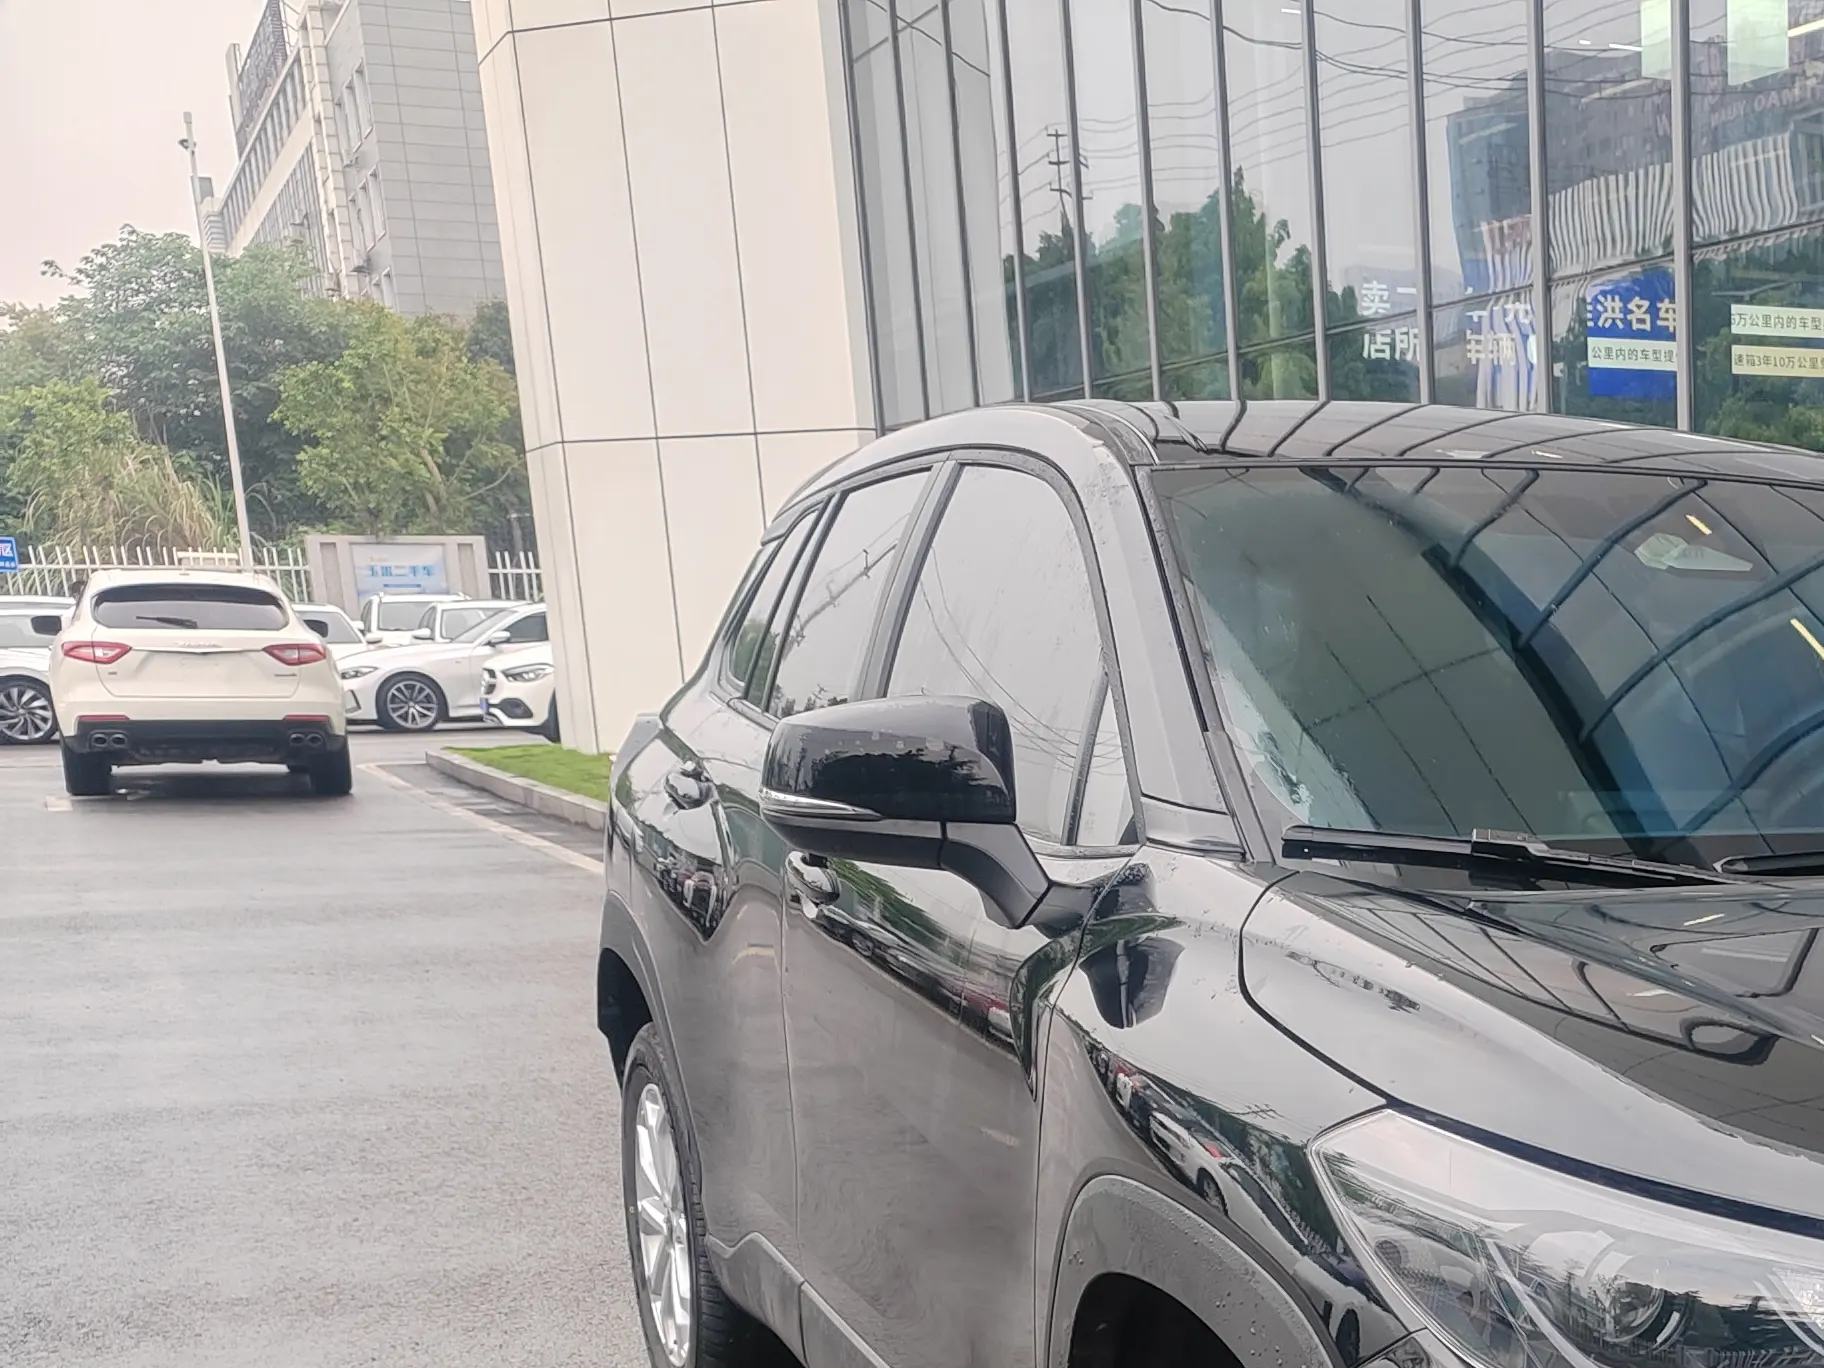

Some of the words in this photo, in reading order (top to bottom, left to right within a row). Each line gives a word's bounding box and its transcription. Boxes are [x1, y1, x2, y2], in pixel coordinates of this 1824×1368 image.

[1592, 346, 1678, 363] 公里内的车型提
